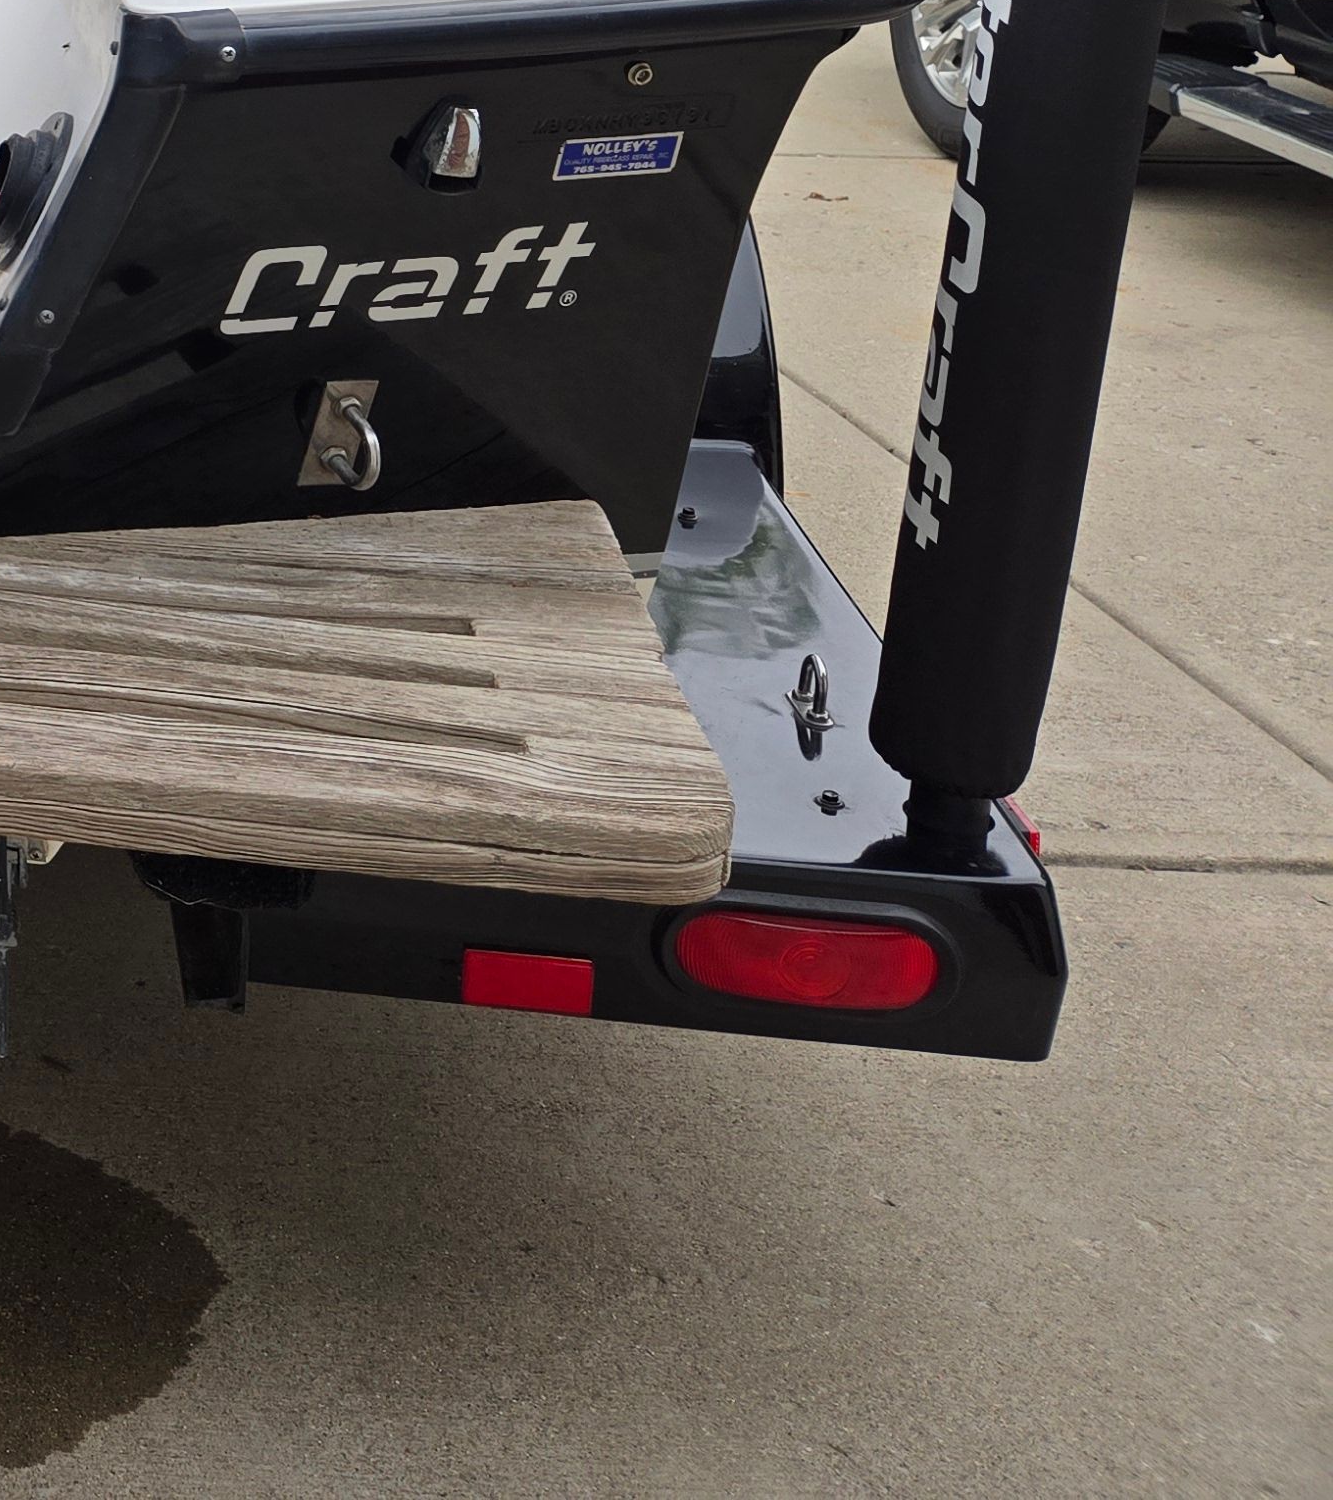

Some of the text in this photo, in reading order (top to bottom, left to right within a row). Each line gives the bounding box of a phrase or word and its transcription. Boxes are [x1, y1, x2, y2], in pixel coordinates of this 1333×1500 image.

[583, 140, 658, 156] NOLLEY'S
[564, 157, 593, 166] QUALITY
[593, 155, 631, 165] FIBERGLASS
